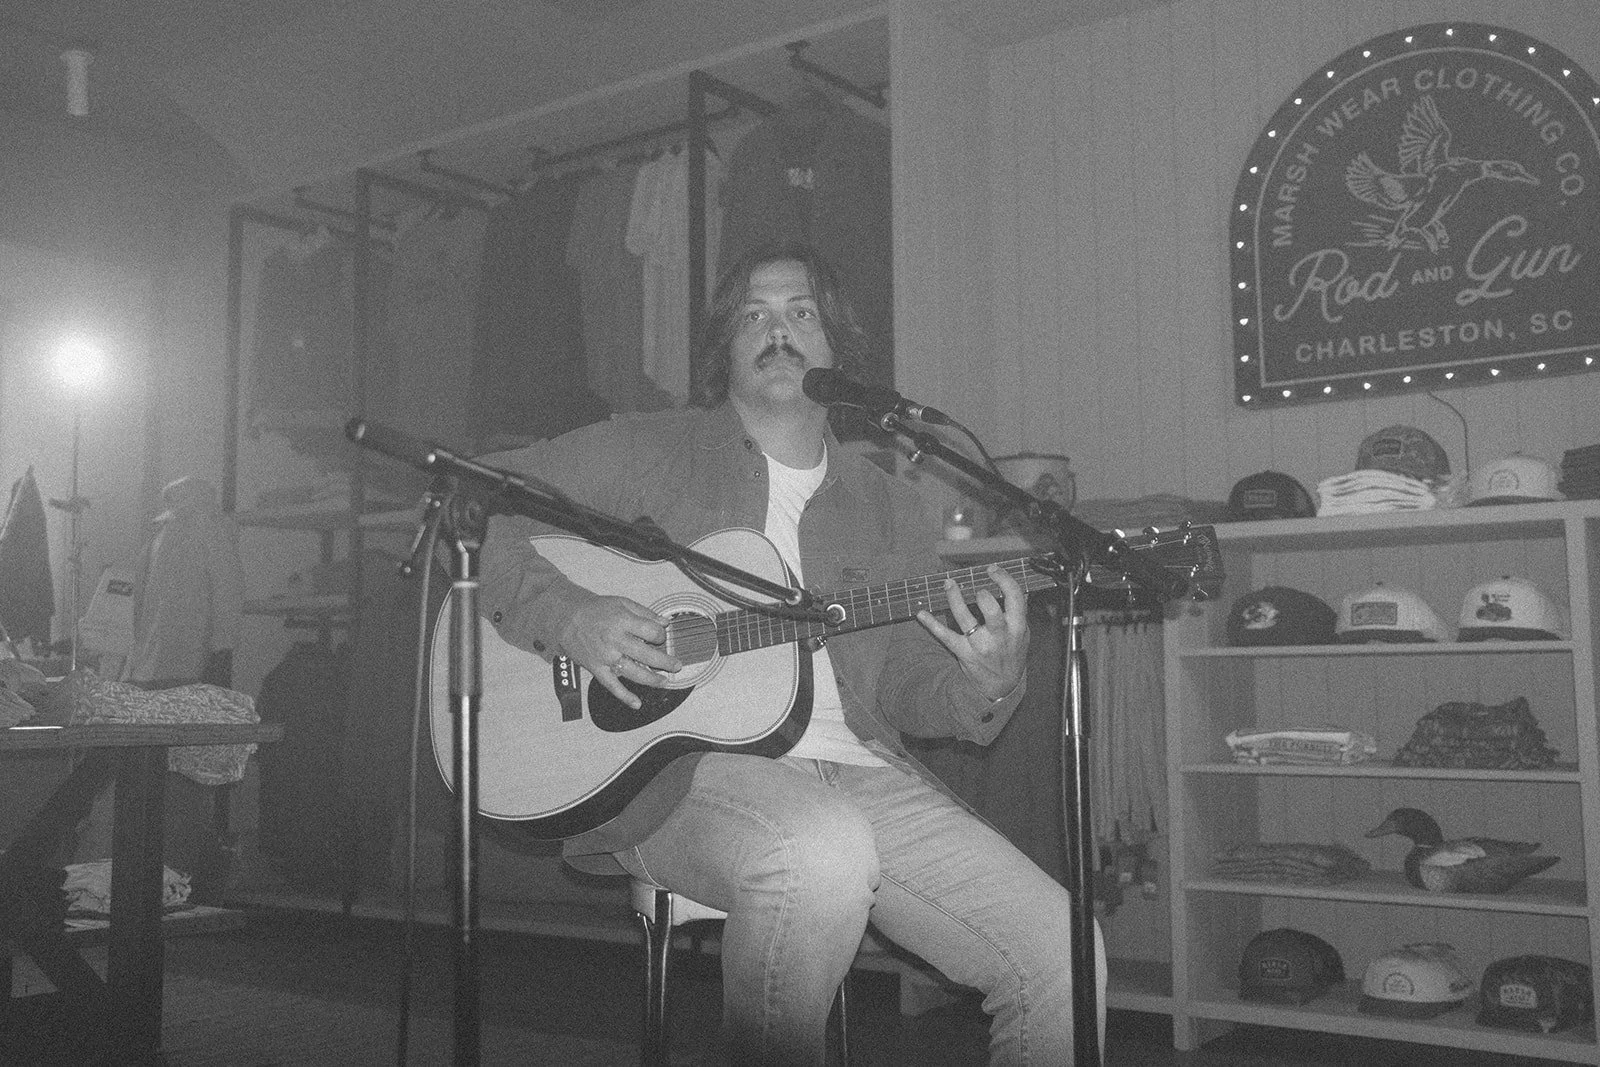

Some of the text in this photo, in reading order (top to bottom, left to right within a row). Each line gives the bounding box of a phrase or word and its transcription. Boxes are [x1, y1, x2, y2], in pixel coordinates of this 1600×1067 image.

[1273, 67, 1585, 247] MARSH WEAR CLOTHING CO.
[1273, 214, 1583, 323] Rod AND Gun
[1296, 309, 1573, 362] CHARLESTON, SC
